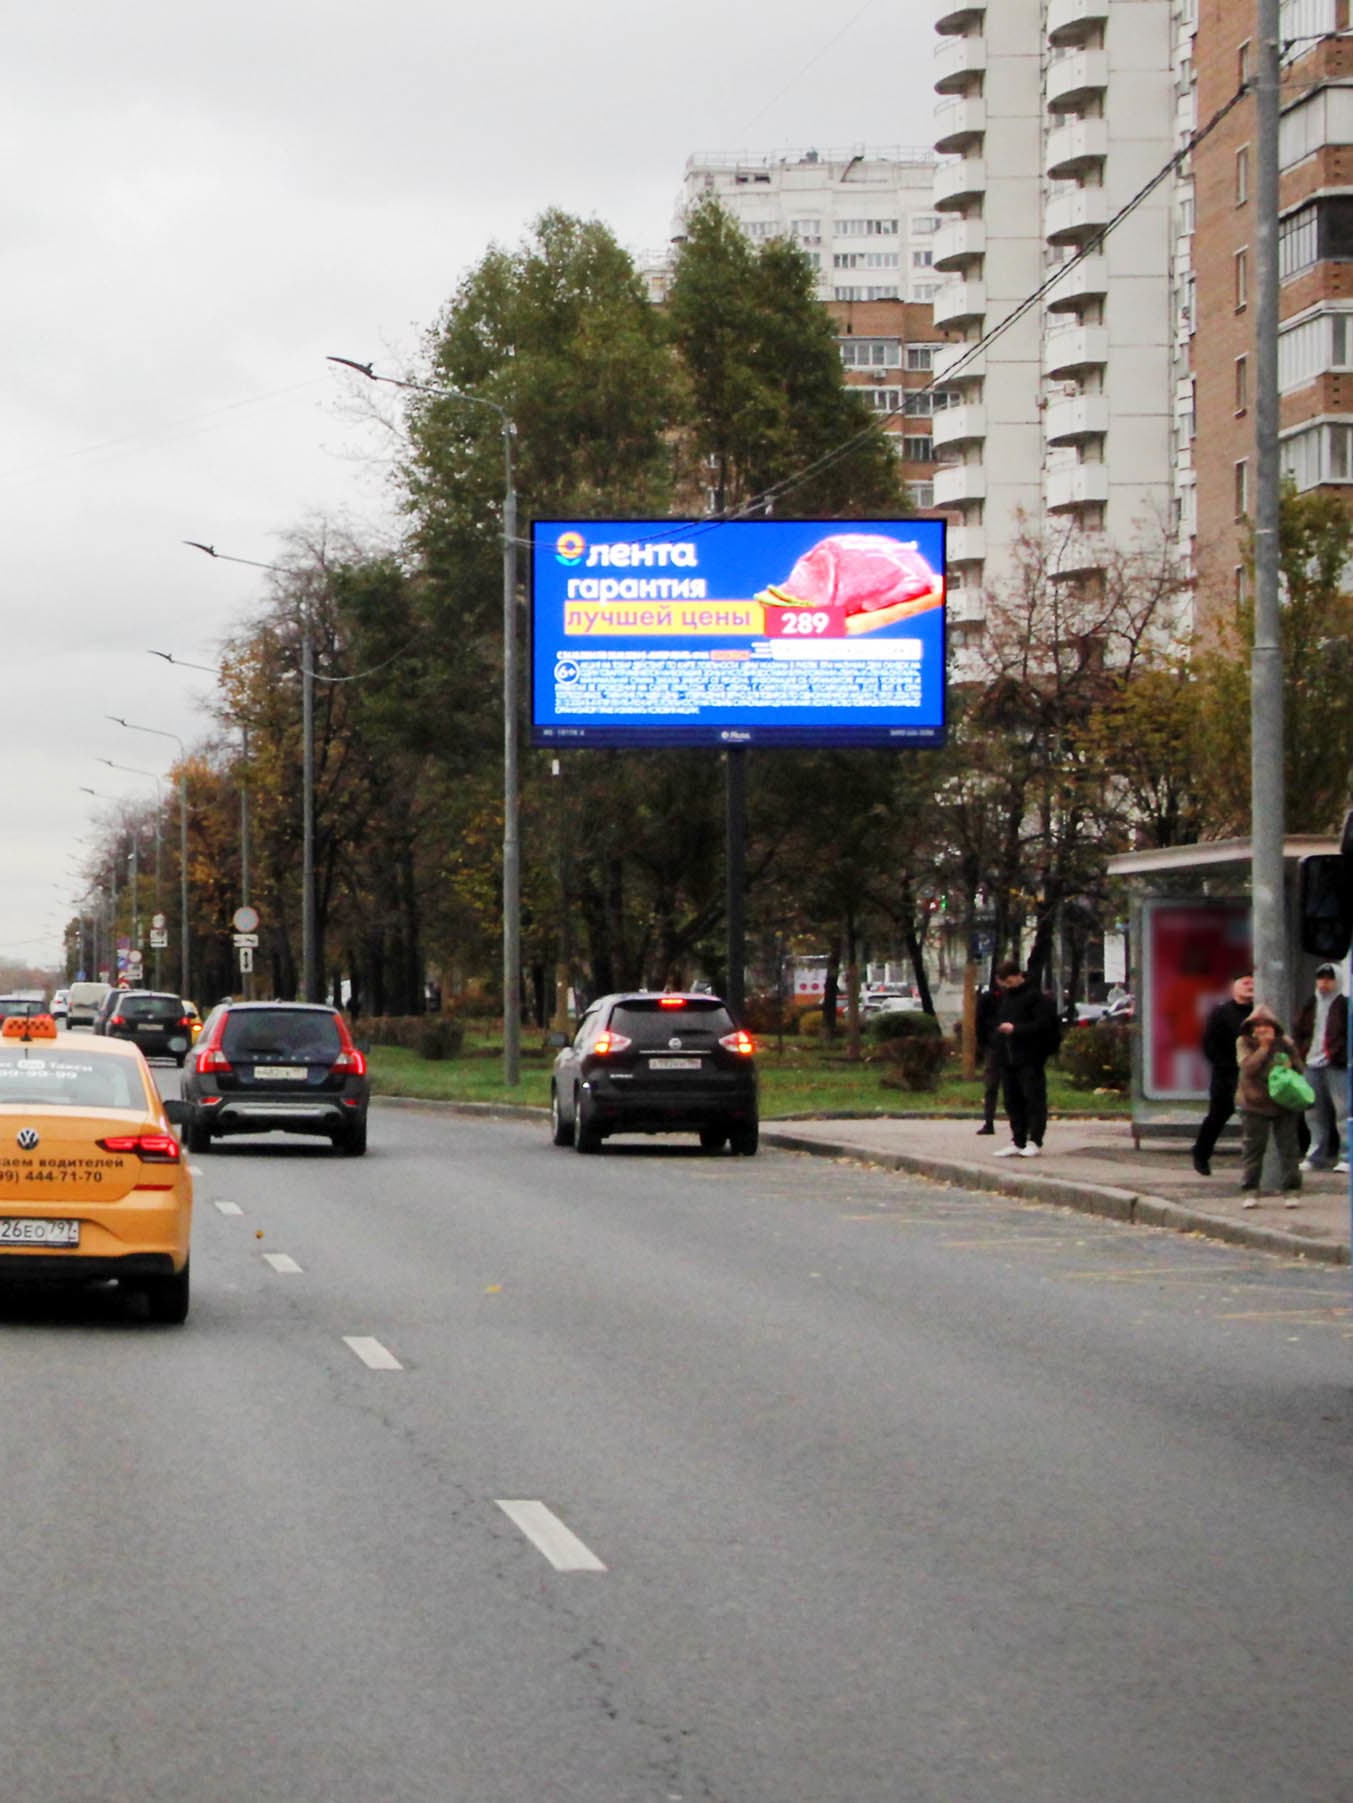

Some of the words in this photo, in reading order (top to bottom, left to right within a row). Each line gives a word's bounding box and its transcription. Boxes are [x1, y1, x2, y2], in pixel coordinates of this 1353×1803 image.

[586, 543, 697, 567] лента
[567, 578, 706, 605] гарантия
[567, 605, 672, 633] лучшей
[682, 611, 751, 629] цены
[781, 613, 829, 634] 289
[39, 1156, 124, 1168] водителей
